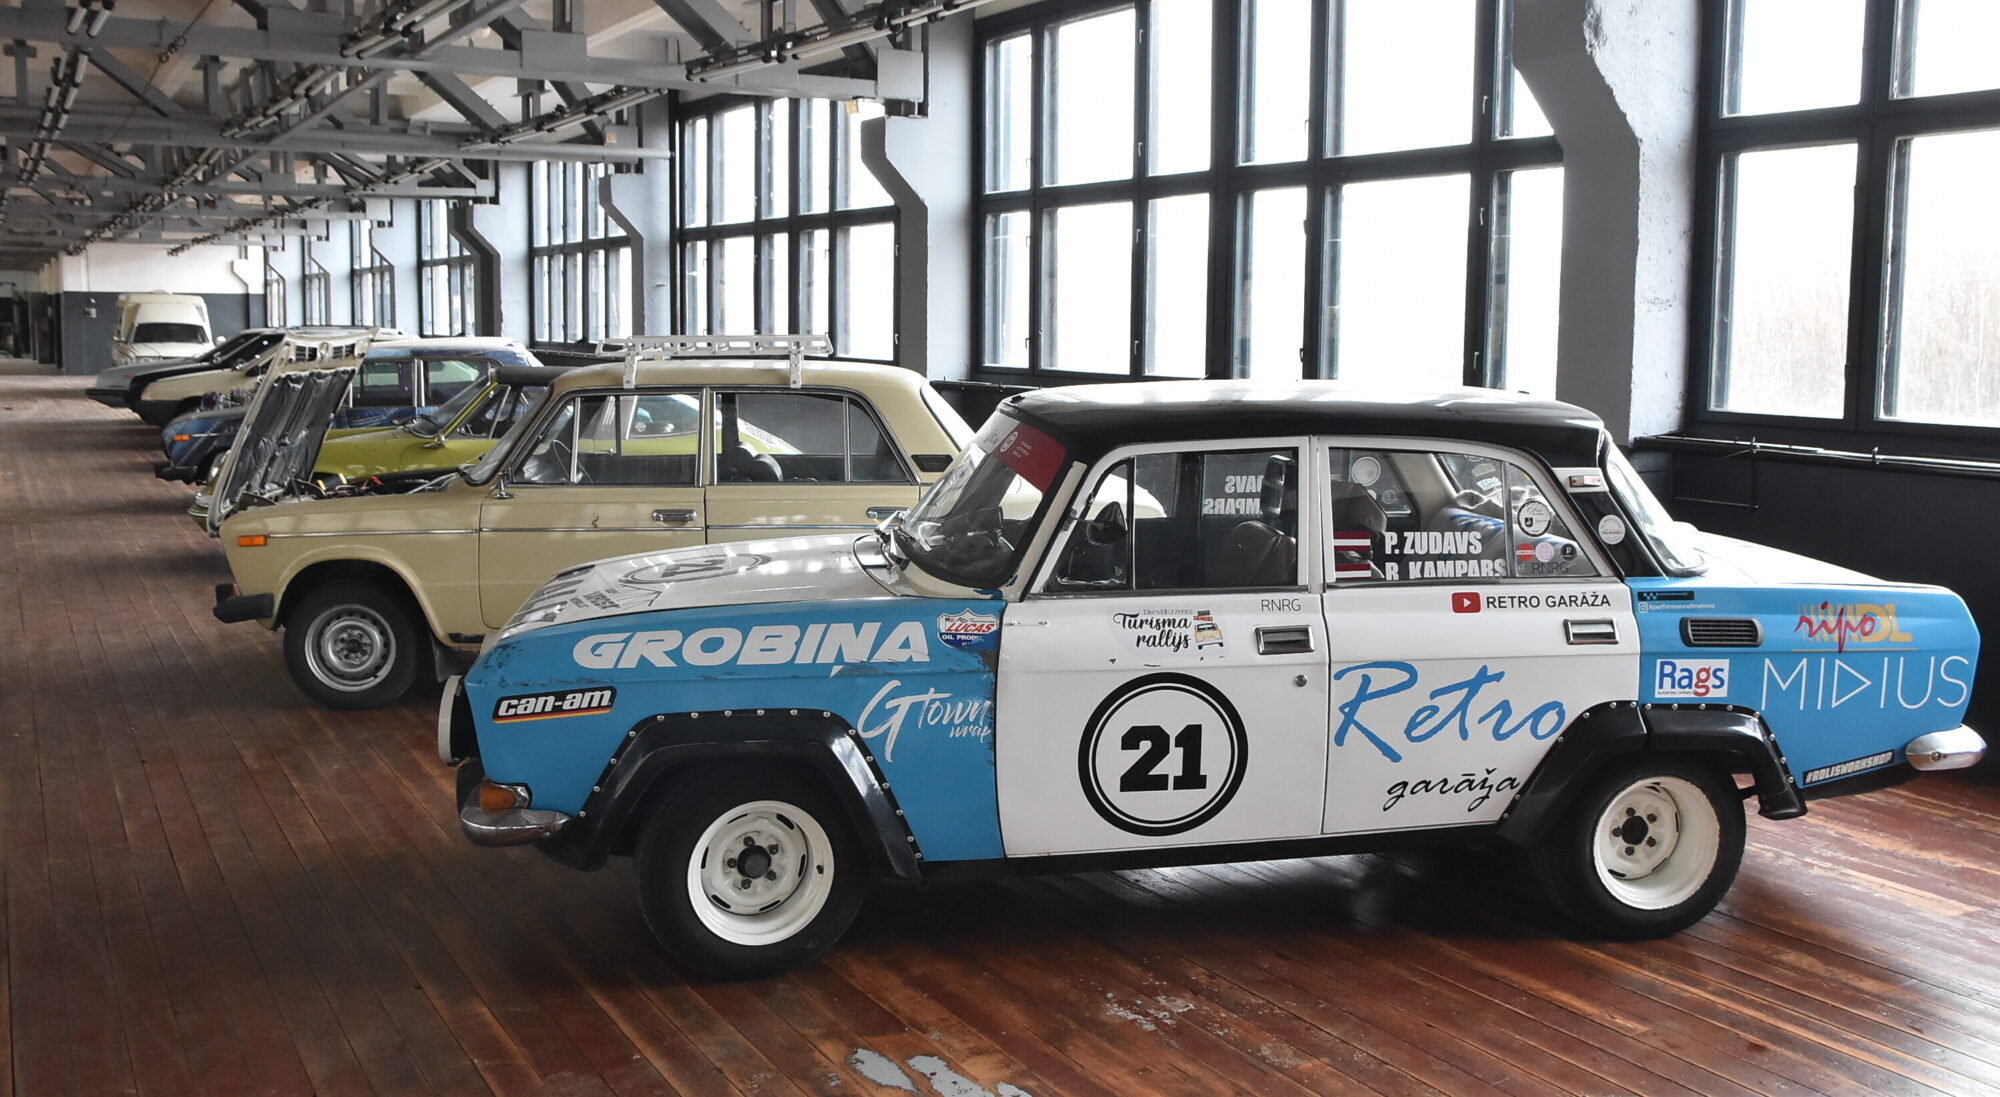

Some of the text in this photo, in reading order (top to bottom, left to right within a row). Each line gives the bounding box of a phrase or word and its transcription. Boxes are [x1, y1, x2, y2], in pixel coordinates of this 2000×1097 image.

[1403, 531, 1482, 555] ZUDAVS
[1409, 559, 1506, 579] KAMPARS
[1531, 563, 1569, 574] RNRG
[1261, 598, 1301, 612] RNRG
[1486, 591, 1611, 608] RETRO GARĀŽA
[946, 622, 995, 633] LUCAS
[572, 622, 930, 678] GROBIŅA
[1136, 629, 1191, 652] rallijs
[1658, 660, 1725, 697] Rags
[1761, 655, 1969, 710] MIDIUS
[498, 689, 612, 716] can-am
[1333, 660, 1567, 763] Retro
[1119, 723, 1207, 792] 21
[1382, 767, 1521, 812] garāža
